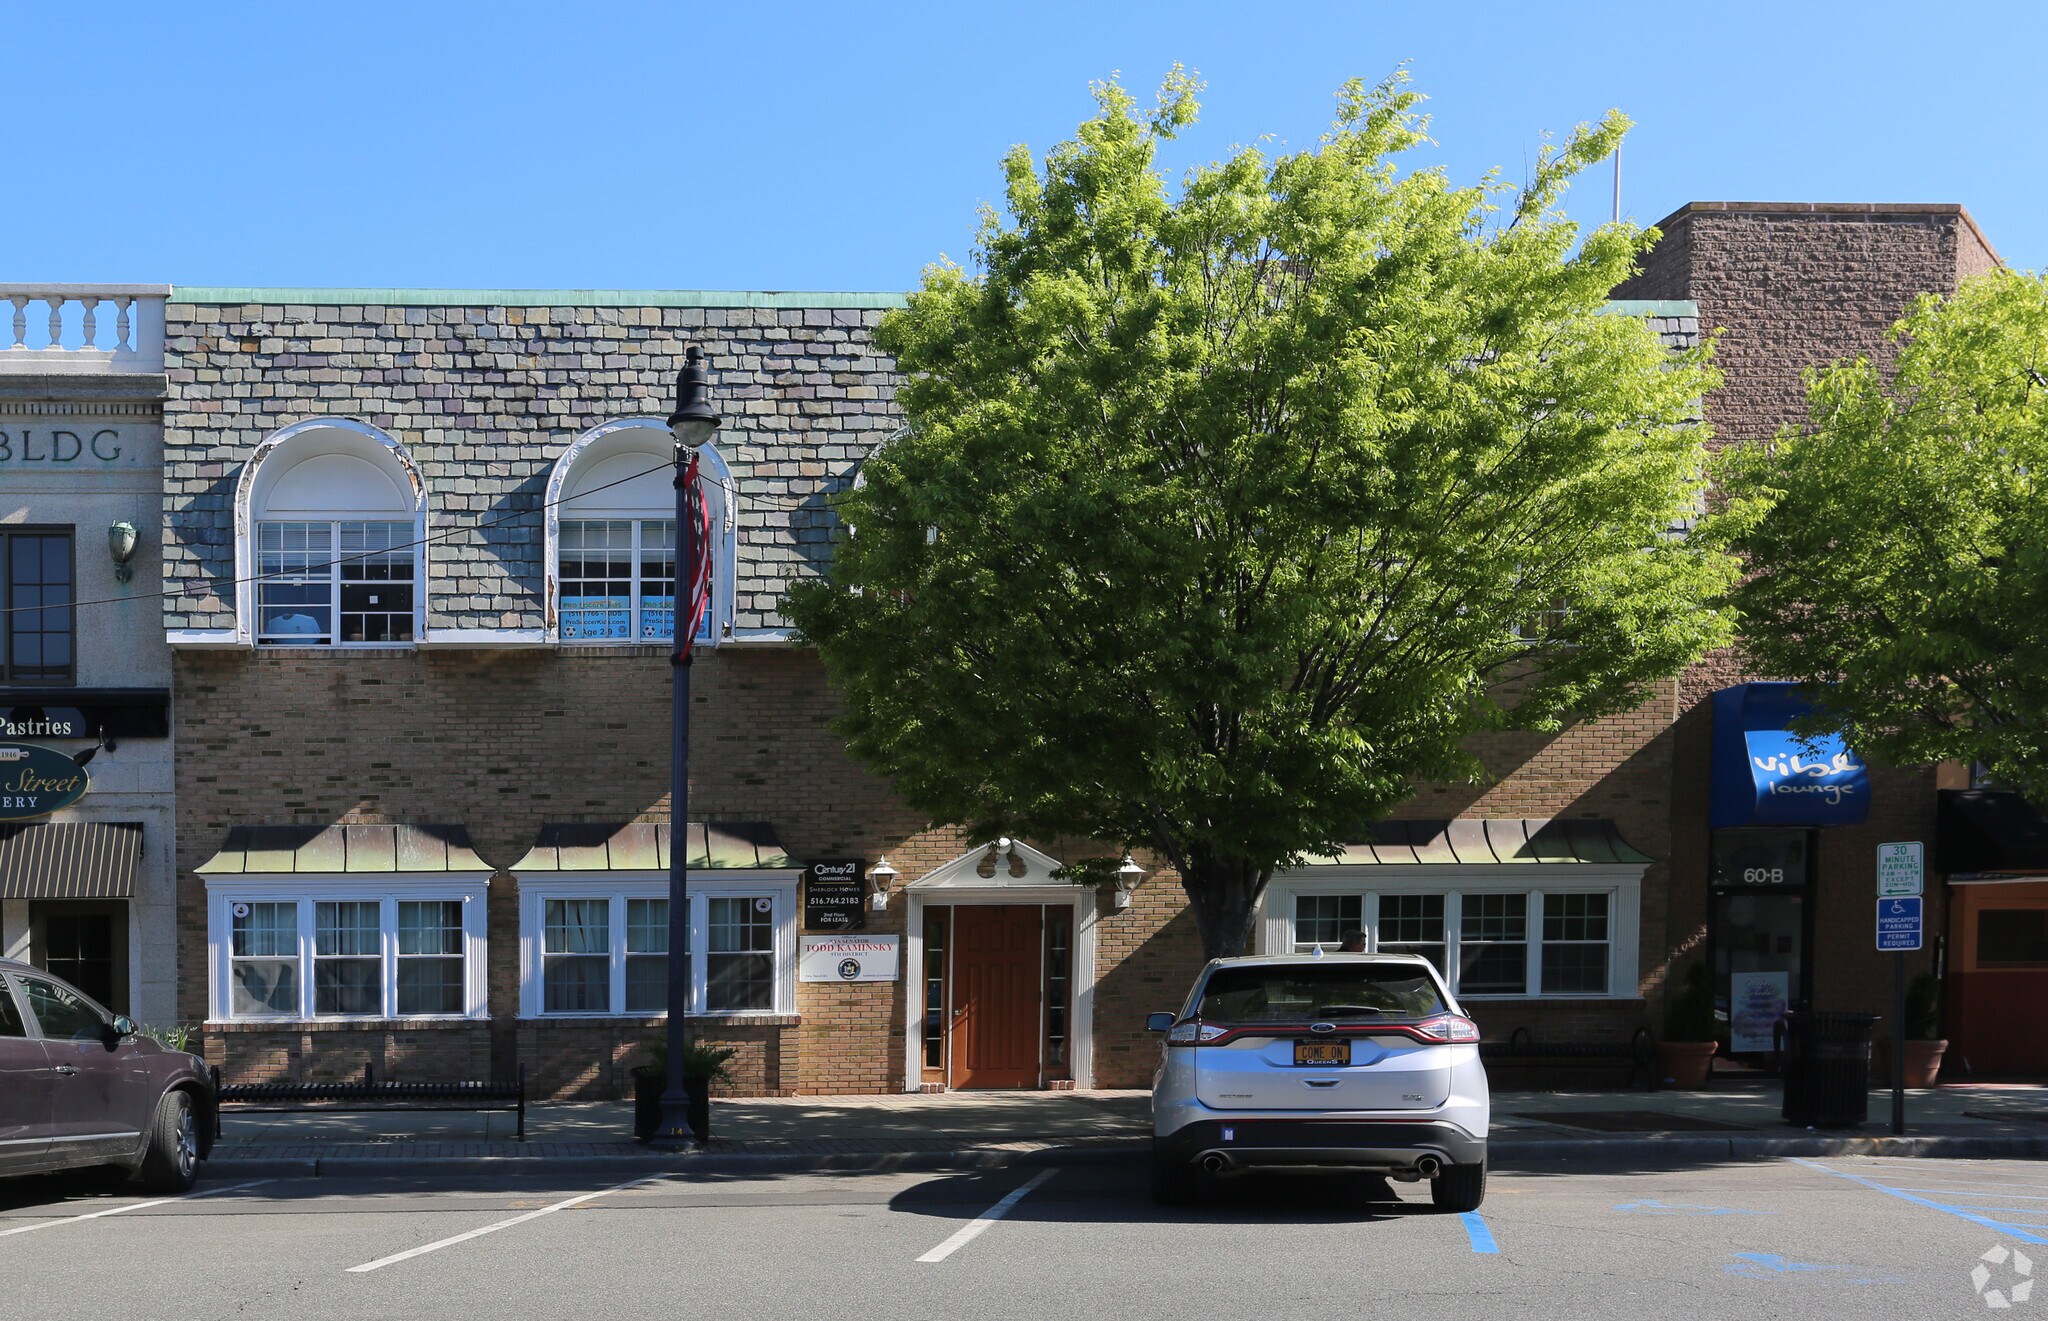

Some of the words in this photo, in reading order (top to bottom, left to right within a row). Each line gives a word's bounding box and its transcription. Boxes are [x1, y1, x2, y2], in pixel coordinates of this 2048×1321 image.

[660, 628, 674, 636] Ag
[5, 767, 82, 793] Street
[1769, 781, 1854, 805] lounge
[1893, 845, 1907, 856] 30
[1885, 855, 1916, 863] MINUTE
[810, 897, 859, 905] 516.764.2183
[1880, 916, 1920, 924] HANDICAPPED
[804, 944, 835, 952] TODD
[837, 943, 893, 952] KAMINSKY
[1302, 1046, 1325, 1059] COME
[1331, 1046, 1343, 1058] ON
